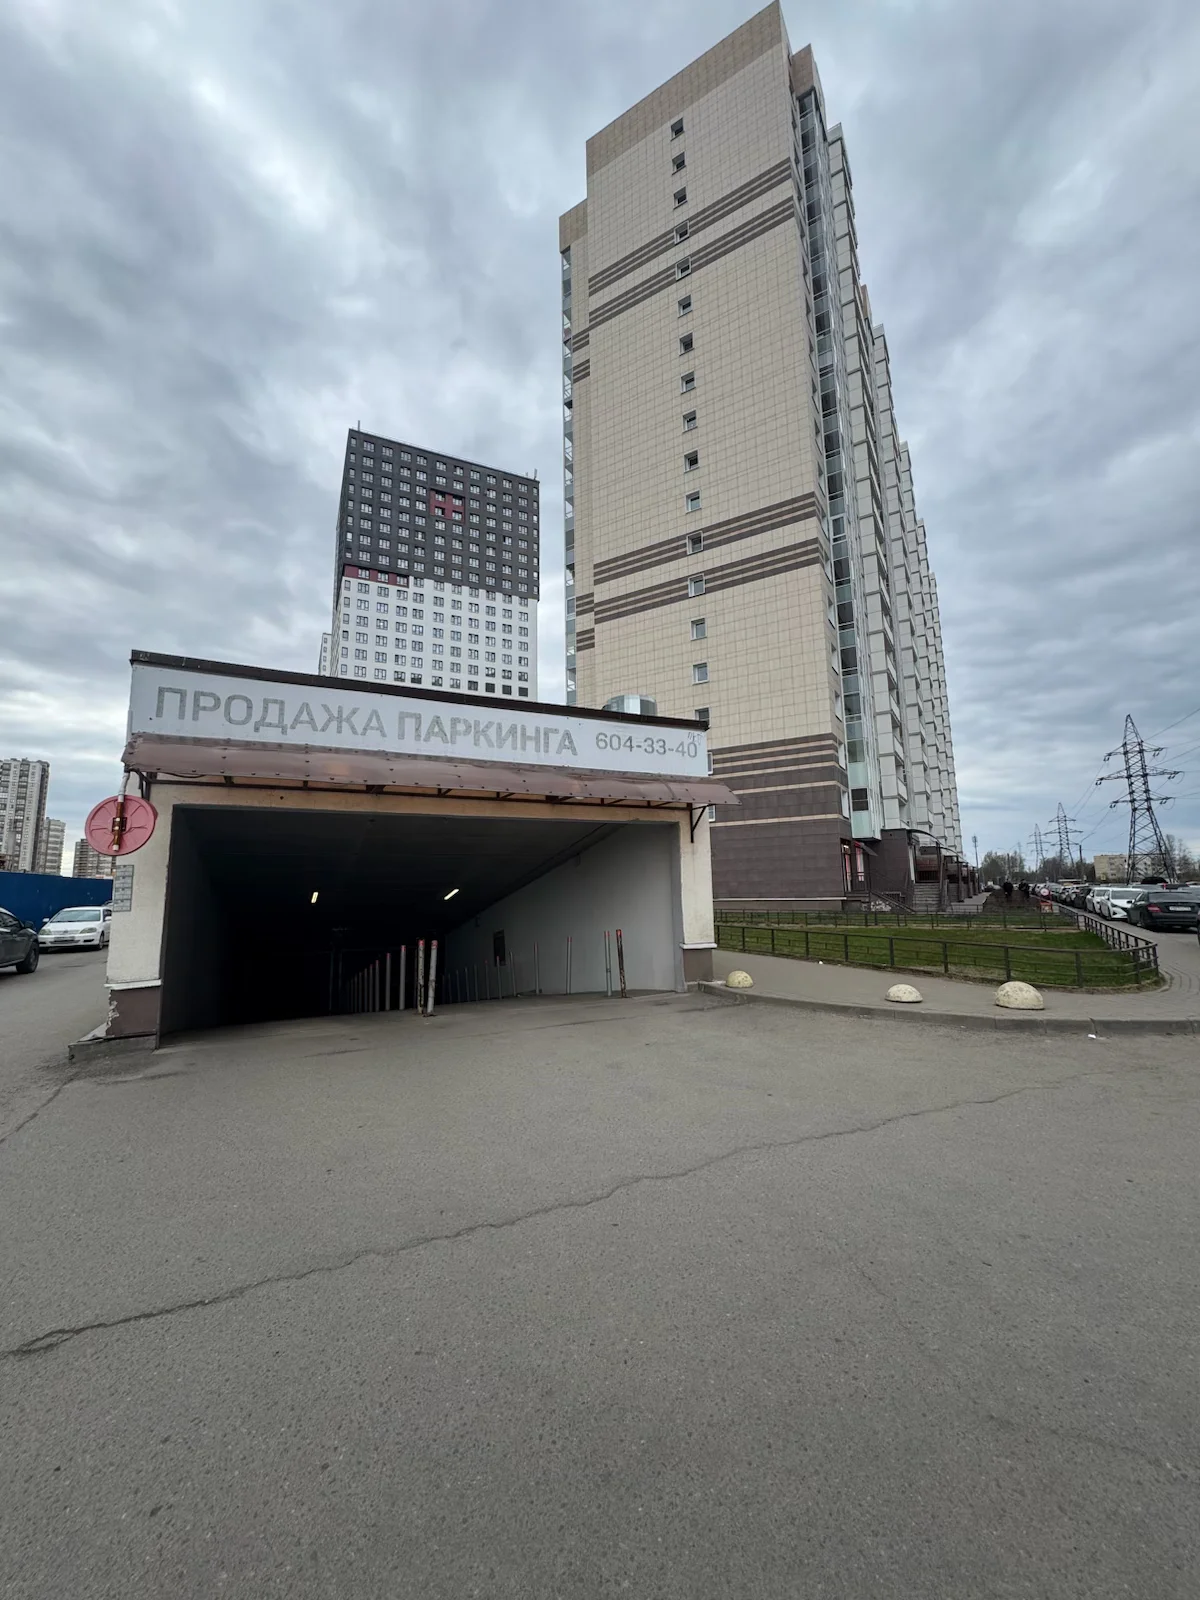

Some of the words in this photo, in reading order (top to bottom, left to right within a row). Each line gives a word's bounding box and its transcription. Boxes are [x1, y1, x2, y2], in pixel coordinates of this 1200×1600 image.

[156, 687, 387, 737] ПРОДАЖА
[397, 712, 577, 756] ПАРКИНГА
[595, 732, 698, 758] 604-33-40
